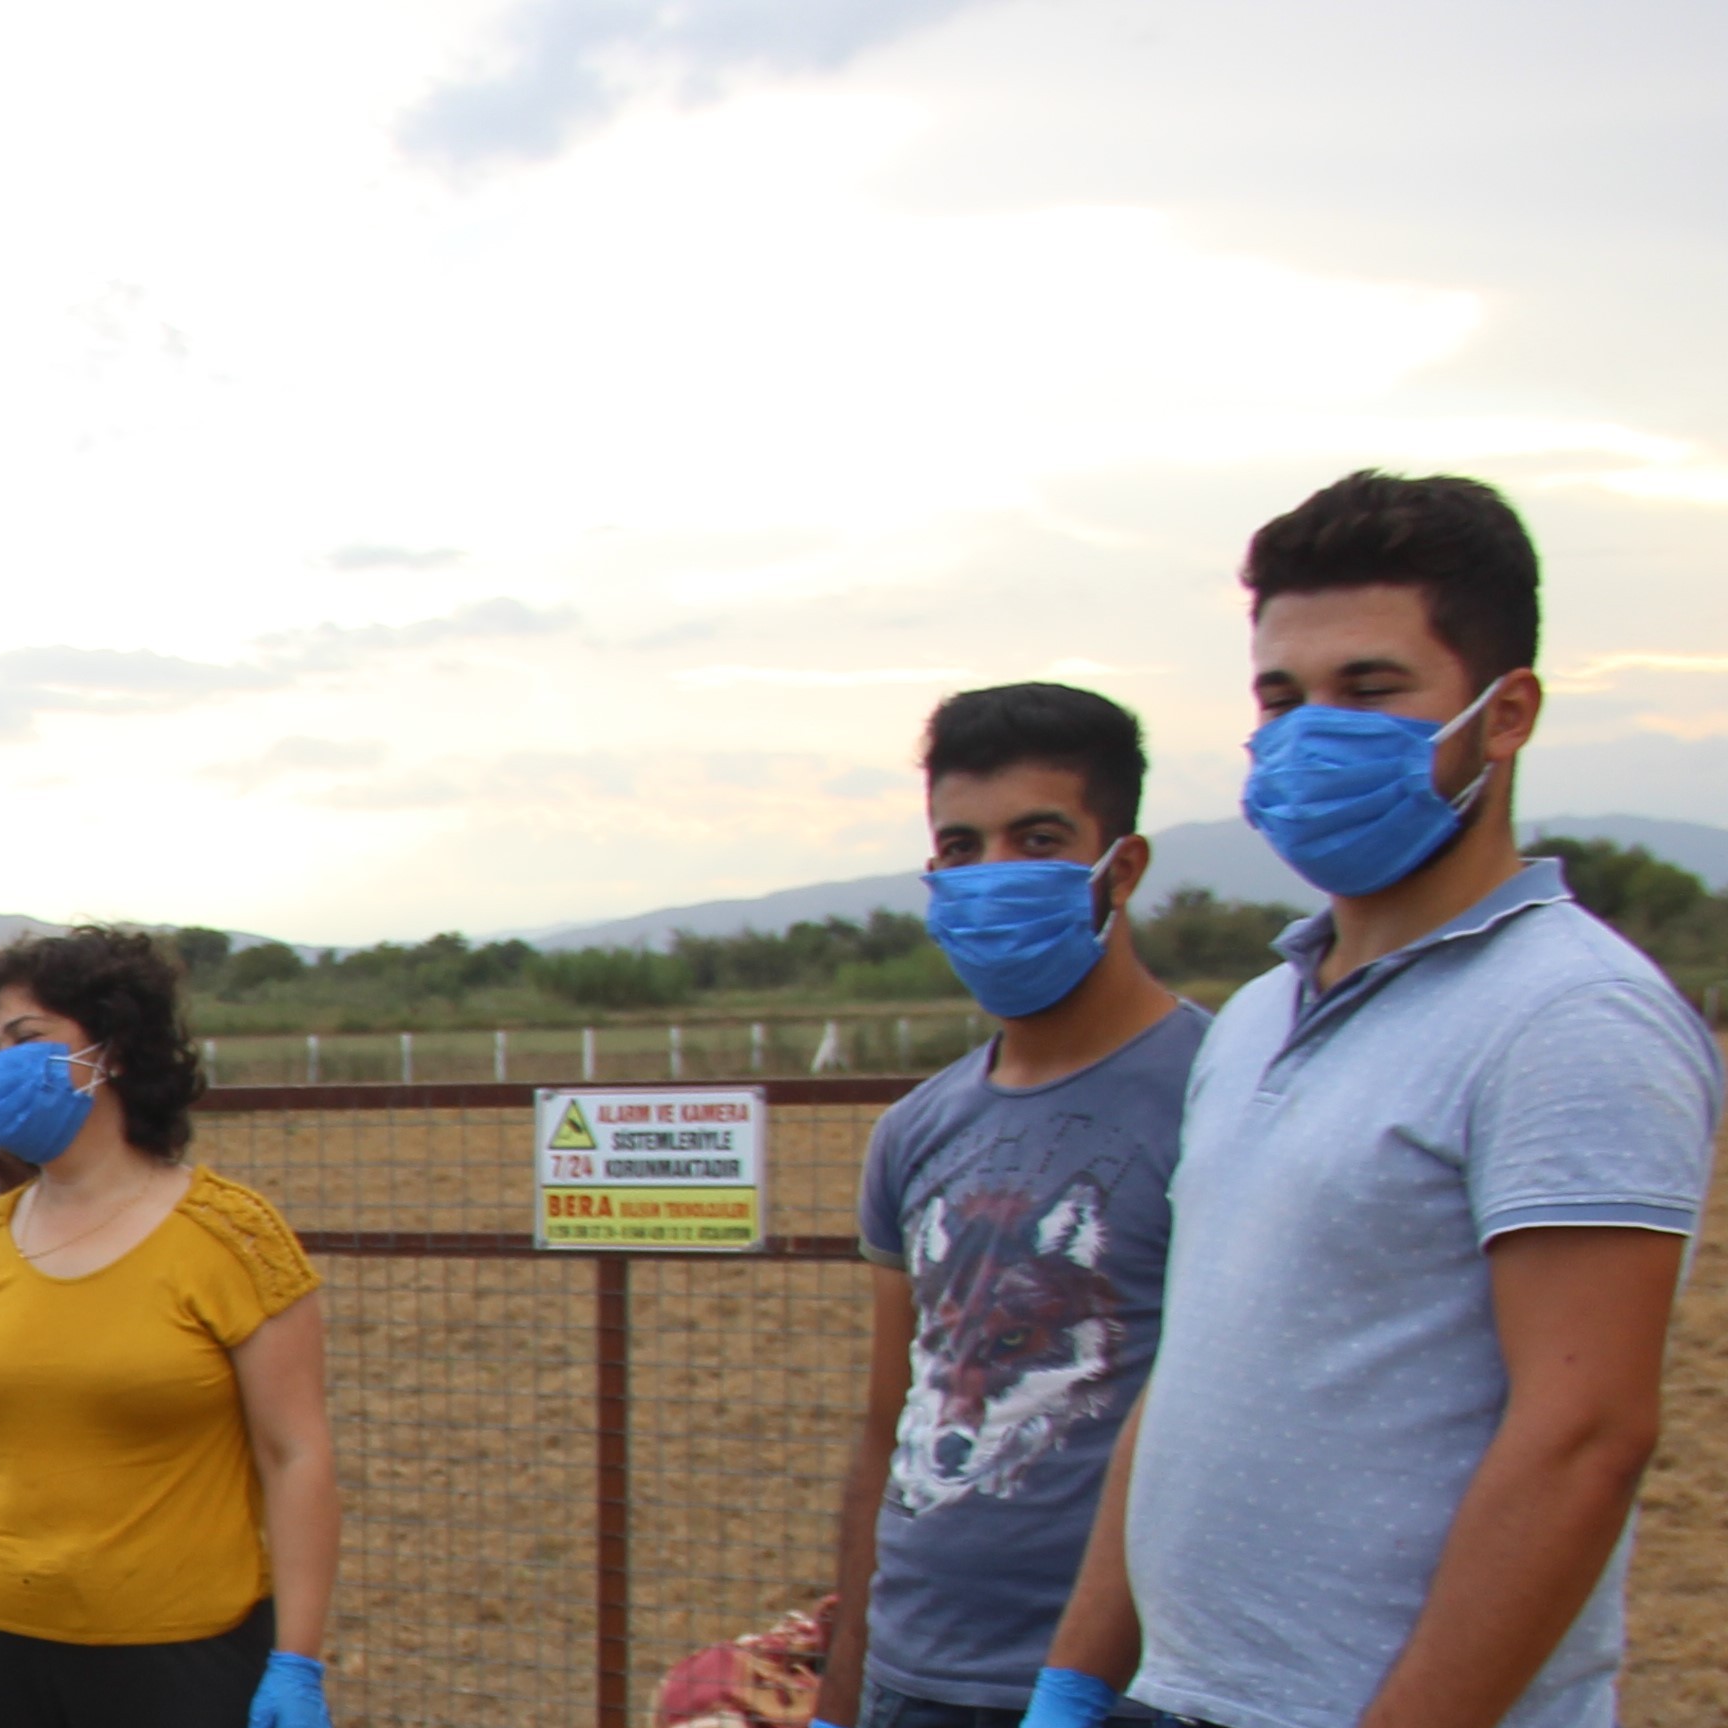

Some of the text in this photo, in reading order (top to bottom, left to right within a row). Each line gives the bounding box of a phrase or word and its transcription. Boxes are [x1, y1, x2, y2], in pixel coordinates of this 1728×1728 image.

[657, 1104, 674, 1122] VE
[681, 1104, 748, 1122] KAMERA
[548, 1195, 613, 1217] BERA
